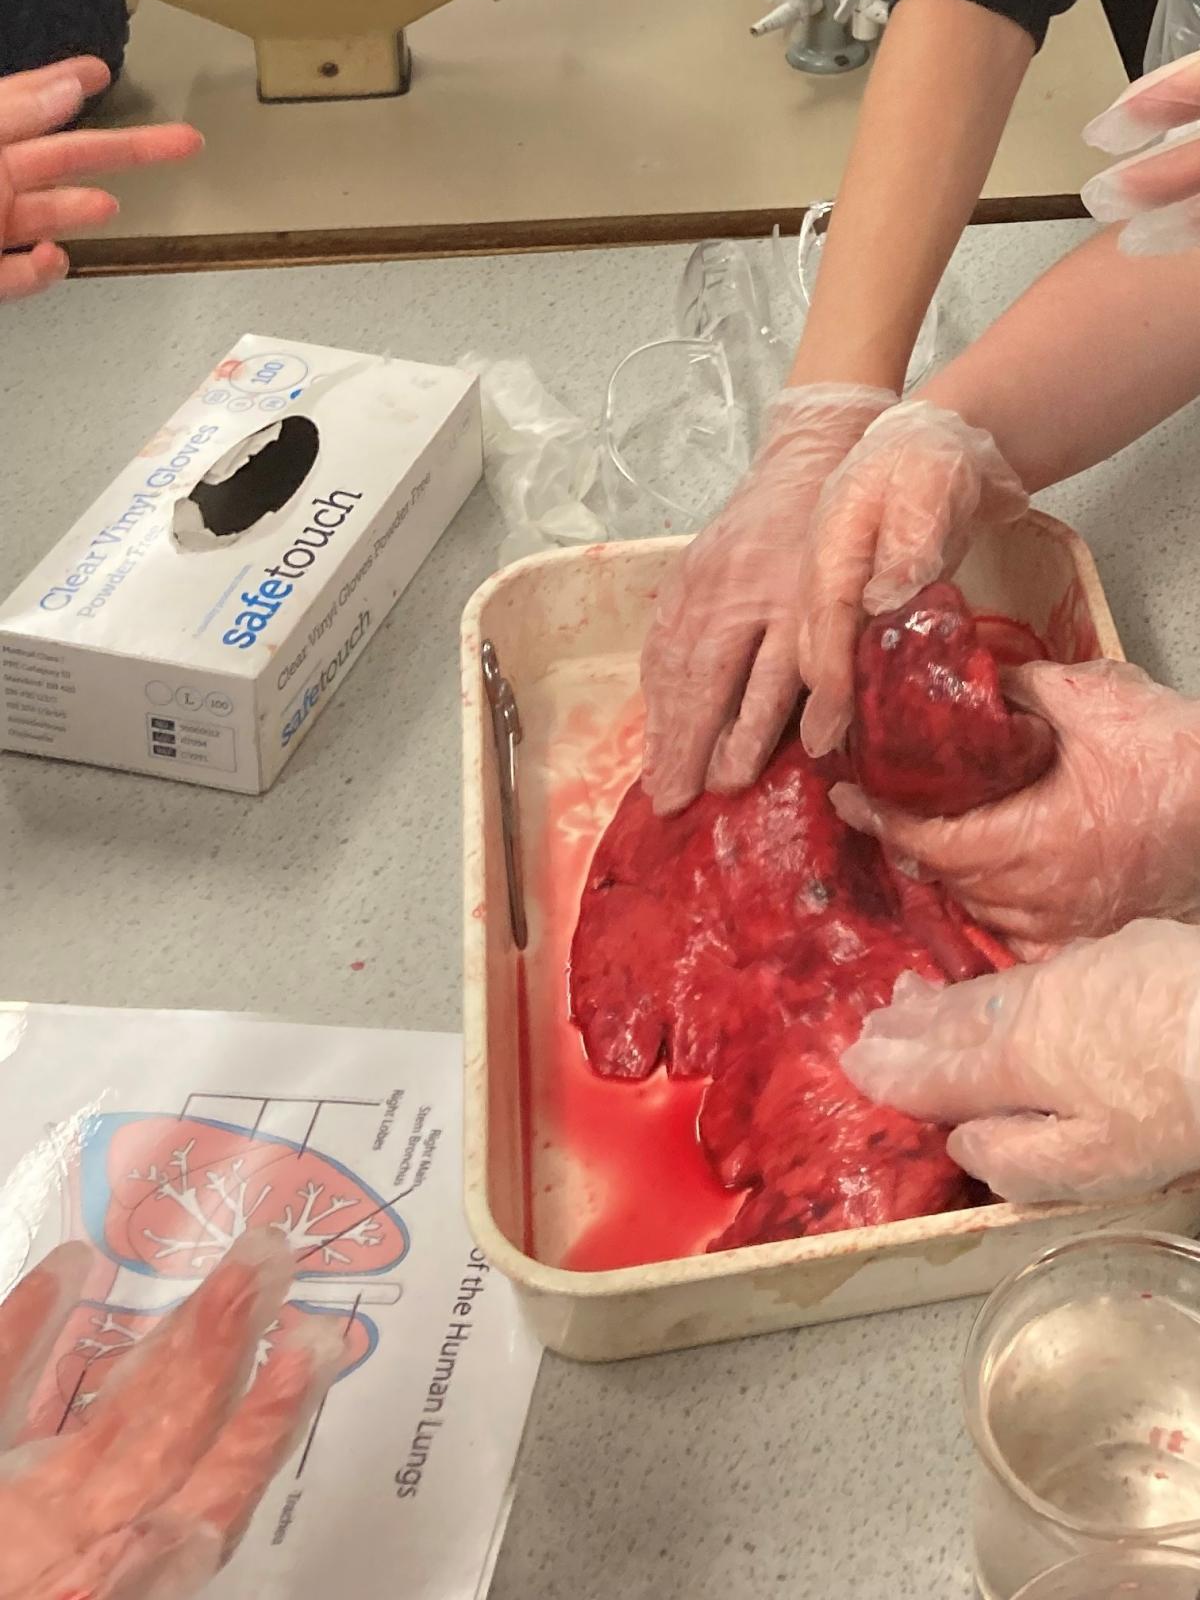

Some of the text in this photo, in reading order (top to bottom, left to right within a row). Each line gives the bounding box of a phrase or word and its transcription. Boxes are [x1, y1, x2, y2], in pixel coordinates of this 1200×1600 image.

[251, 362, 284, 384] 100
[40, 551, 107, 611] Clear
[91, 492, 161, 547] Vinyl
[146, 424, 219, 489] Gloves
[77, 524, 165, 619] Powder Free
[222, 489, 363, 649] safetouch
[277, 648, 309, 692] Clear
[307, 607, 338, 646] Vinyl
[338, 553, 374, 608] Gloves
[372, 505, 410, 558] Powder
[184, 692, 195, 705] L
[211, 699, 229, 710] 100
[281, 609, 371, 748] safetouch
[372, 1089, 405, 1151] Right Lobes
[393, 1104, 432, 1187] Stem Bronchus
[414, 1129, 442, 1187] Right Main
[395, 1247, 490, 1499] of the Human Lungs
[271, 1489, 303, 1546] Trachea
